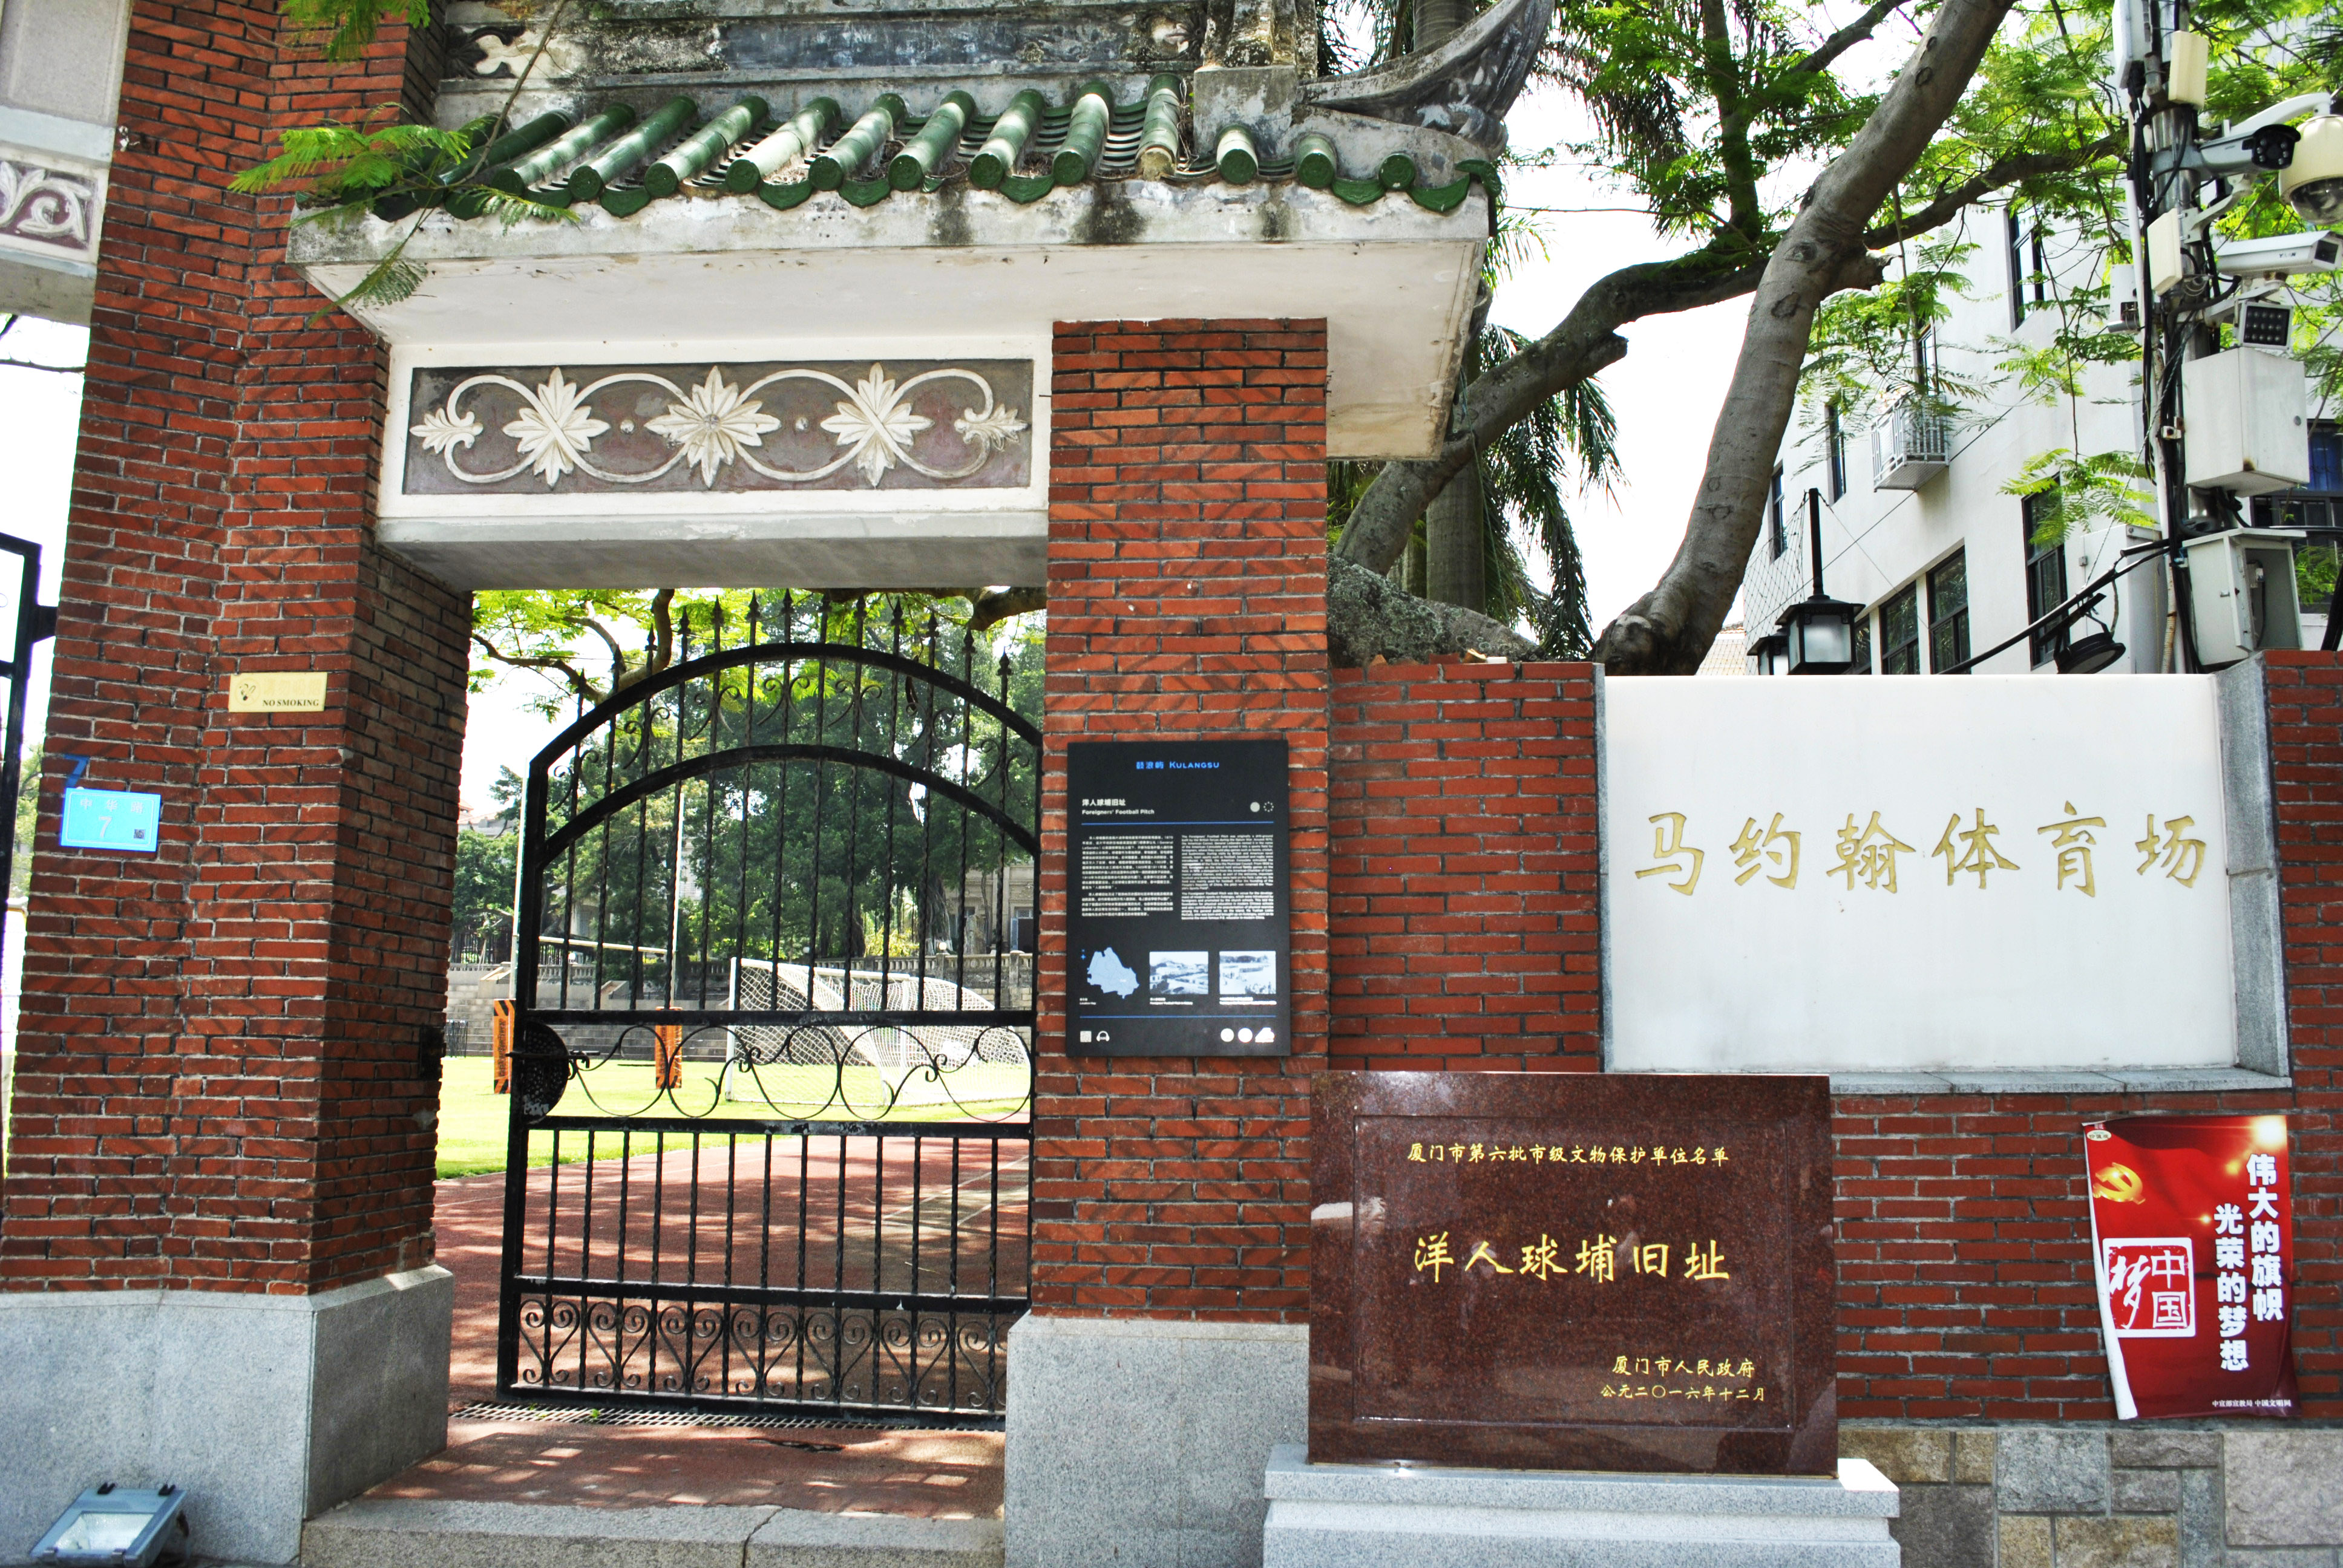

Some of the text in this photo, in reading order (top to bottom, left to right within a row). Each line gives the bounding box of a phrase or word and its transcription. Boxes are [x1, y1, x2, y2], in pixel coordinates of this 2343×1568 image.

[80, 798, 143, 814] 中华路
[98, 816, 113, 838] 7
[1635, 802, 2206, 897] 马约翰体育场
[1407, 1142, 1729, 1166] 厦门市第六批市级文物保护单位名单
[1414, 1230, 1729, 1284] 洋人球埔旧址
[2246, 1153, 2283, 1322] 伟大的旗帜
[2214, 1203, 2249, 1371] 光荣的梦想
[1612, 1354, 1755, 1378] 厦门市人民政府
